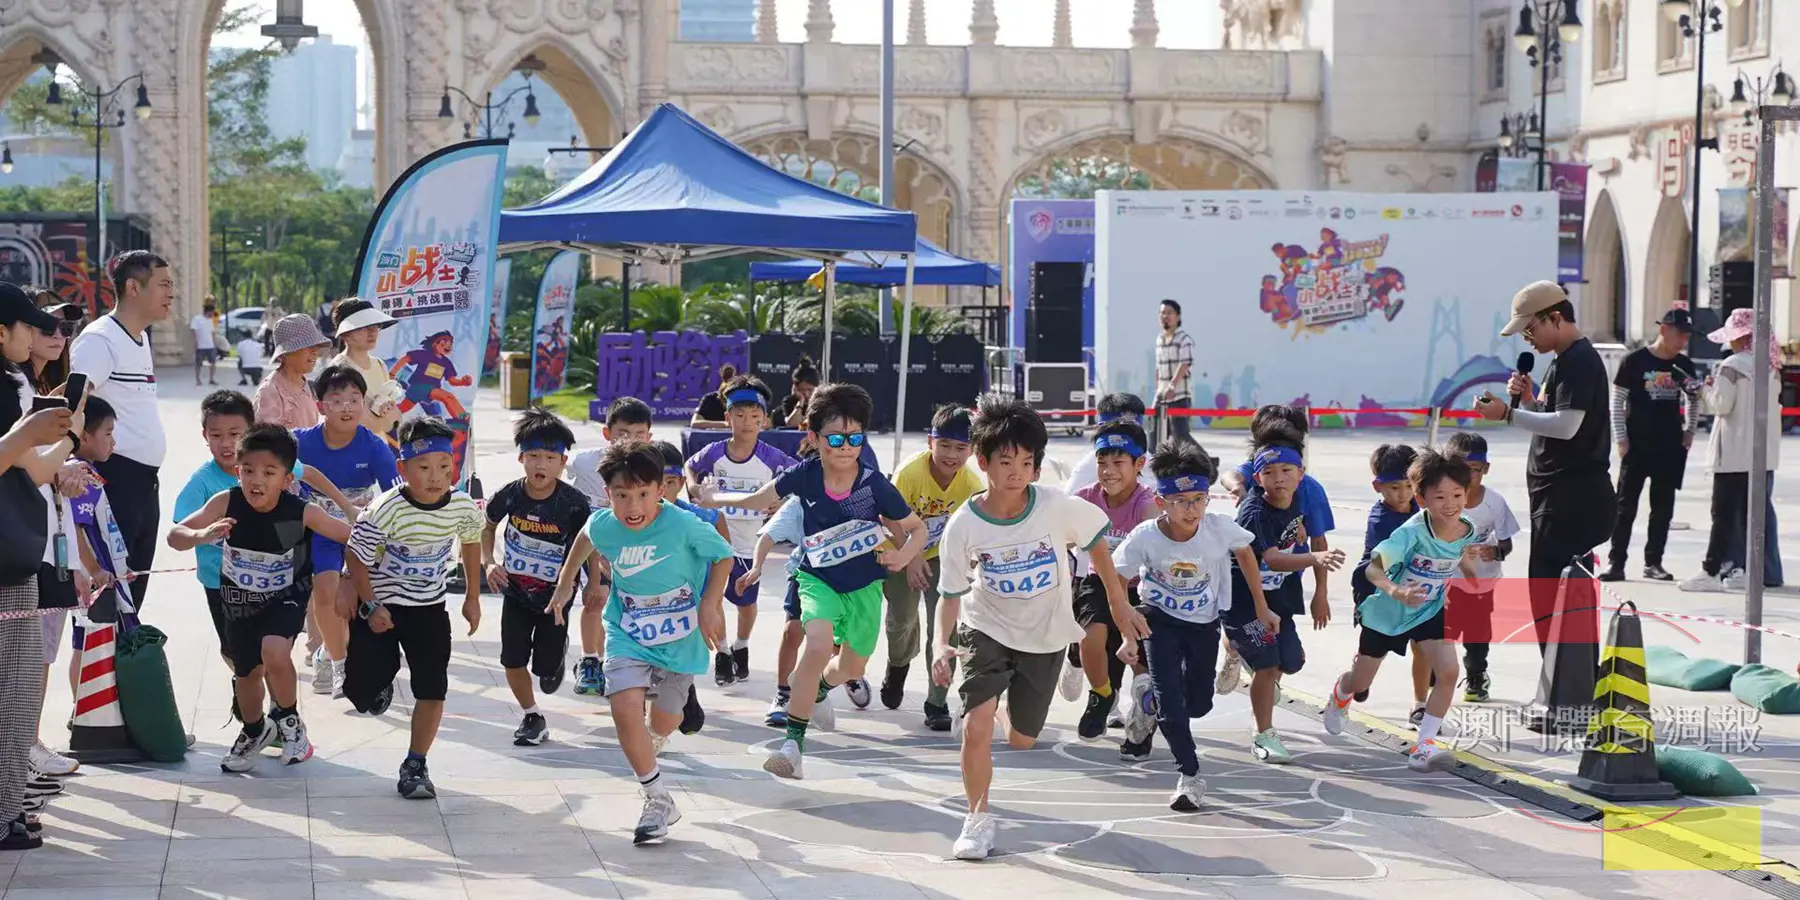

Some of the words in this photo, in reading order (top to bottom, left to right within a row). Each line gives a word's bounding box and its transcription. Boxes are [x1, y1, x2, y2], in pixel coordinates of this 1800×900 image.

[618, 544, 658, 565] NIKE
[816, 533, 879, 564] 2040
[983, 570, 1052, 593] 2042
[1148, 588, 1210, 612] 2048
[627, 615, 691, 641] 2041
